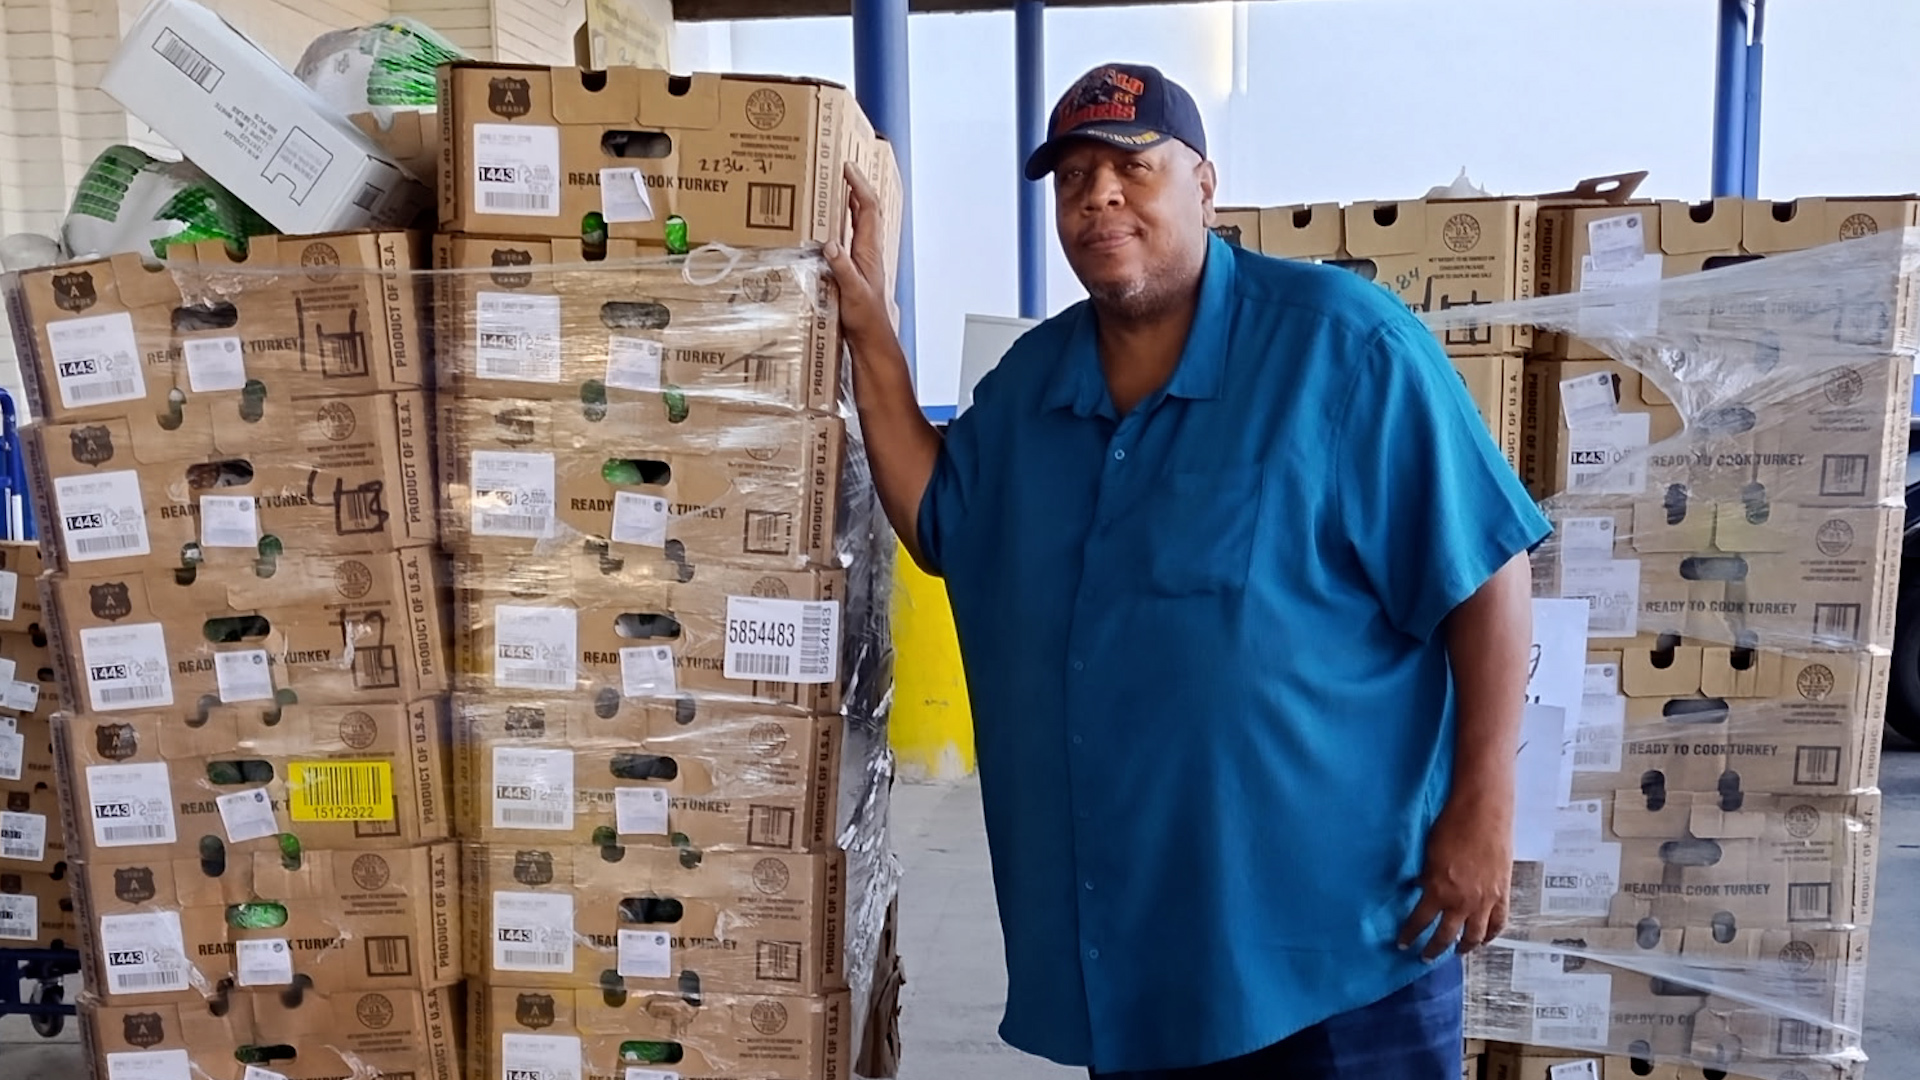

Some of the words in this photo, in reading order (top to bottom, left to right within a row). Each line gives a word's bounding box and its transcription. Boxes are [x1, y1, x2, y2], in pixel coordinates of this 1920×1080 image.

[505, 92, 514, 103] A
[442, 79, 450, 144] PRODUCT
[495, 106, 525, 114] GRADE
[823, 97, 834, 137] U.S.A.
[443, 148, 451, 166] OF
[822, 140, 831, 160] OF
[479, 167, 515, 183] 1443
[568, 173, 601, 186] READ
[678, 177, 729, 193] TURKEY
[818, 163, 830, 227] PRODUCT
[1541, 218, 1553, 278] PRODUCT
[1522, 259, 1530, 273] OF
[70, 286, 80, 298] A
[388, 284, 399, 302] OF
[390, 306, 408, 368] PRODUCT
[481, 334, 517, 350] 1443
[250, 337, 300, 354] TURKEY
[675, 349, 726, 365] TURKEY
[60, 360, 96, 377] 1443
[814, 335, 826, 396] PRODUCT
[1510, 370, 1518, 405] U.S.A.
[1527, 373, 1538, 430] PRODUCT
[400, 399, 412, 437] U.S.A.
[1509, 411, 1517, 427] OF
[818, 427, 828, 465] U.S.A.
[1526, 434, 1536, 451] OF
[403, 444, 414, 459] OF
[1571, 451, 1605, 464] 1443
[1756, 453, 1805, 467] TURKEY
[816, 469, 826, 485] OF
[405, 464, 421, 523] PRODUCT
[571, 498, 613, 512] READY
[66, 514, 102, 531] 1443
[812, 490, 824, 549] PRODUCT
[407, 556, 420, 593] U.S.A.
[106, 595, 116, 607] A
[412, 599, 424, 613] OF
[1646, 600, 1685, 613] READY
[1690, 600, 1706, 612] TO
[1710, 600, 1744, 614] COOK
[1749, 602, 1797, 615] TURKEY
[729, 619, 796, 648] 5854483
[819, 607, 832, 674] 5854483
[415, 619, 432, 676] PRODUCT
[284, 650, 330, 665] TURKEY
[686, 656, 724, 671] TURK
[92, 665, 127, 681] 1443
[415, 706, 426, 743] U.S.A.
[112, 736, 121, 747] A
[820, 725, 832, 761] U.S.A.
[1629, 743, 1668, 755] READY
[1674, 744, 1689, 755] TO
[1693, 744, 1726, 756] COOK
[1729, 744, 1778, 756] TURKEY
[418, 749, 429, 763] OF
[818, 766, 828, 782] OF
[419, 767, 434, 825] PRODUCT
[497, 786, 531, 800] 1443
[96, 804, 130, 818] 1443
[314, 806, 374, 819] 15122922
[814, 785, 827, 842] PRODUCT
[1863, 844, 1871, 858] OF
[435, 853, 447, 887] U.S.A.
[130, 880, 139, 890] A
[1545, 876, 1578, 889] 1443
[1624, 882, 1661, 894] READY
[1686, 884, 1720, 896] COOK
[1724, 884, 1771, 896] TURKEY
[436, 893, 446, 909] OF
[827, 900, 837, 914] OF
[437, 912, 449, 968] PRODUCT
[499, 929, 532, 942] 1443
[826, 918, 837, 975] PRODUCT
[110, 952, 143, 965] 1443
[530, 1004, 539, 1016] A
[1658, 1013, 1673, 1025] TO
[139, 1024, 148, 1035] A
[432, 1023, 443, 1039] OF
[825, 1045, 837, 1060] OF
